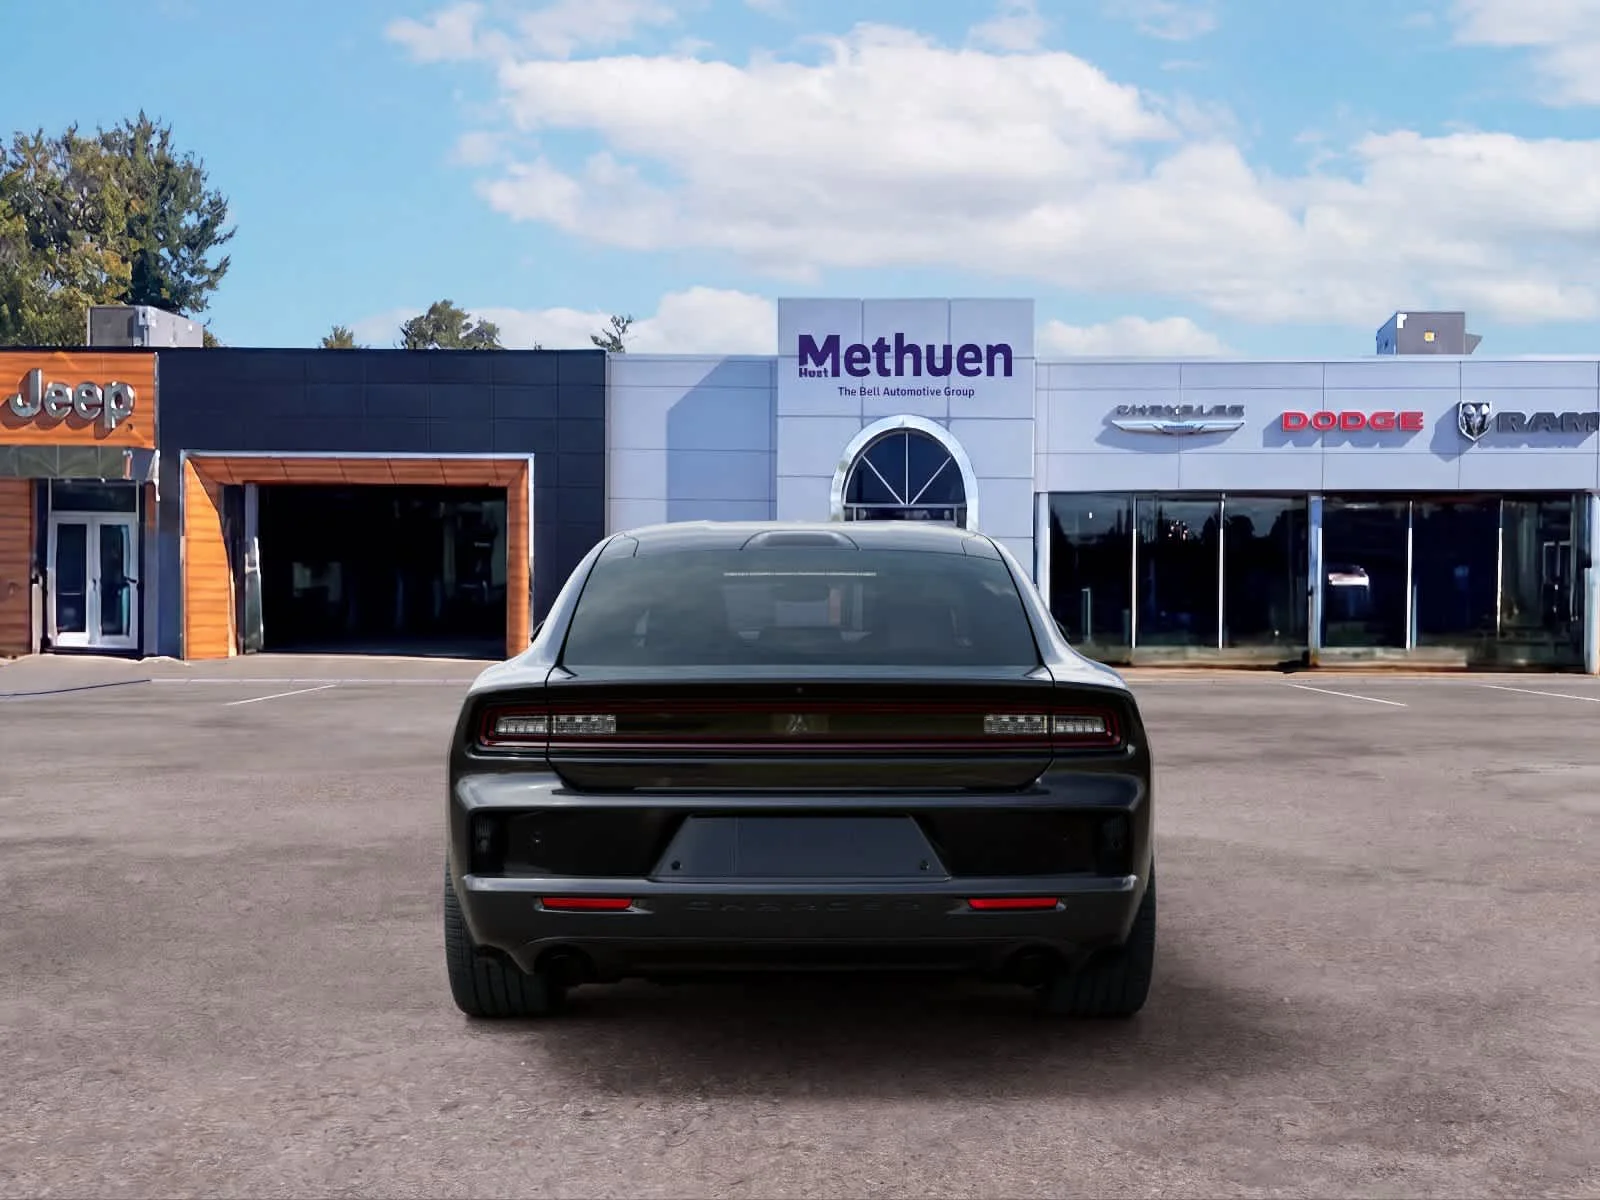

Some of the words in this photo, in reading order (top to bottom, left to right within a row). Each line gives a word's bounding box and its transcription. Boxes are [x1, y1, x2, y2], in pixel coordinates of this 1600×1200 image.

[798, 333, 1013, 377] Methuen
[9, 368, 135, 429] Jeep
[838, 386, 857, 396] The
[860, 386, 880, 396] Bell
[883, 386, 941, 397] Automotive
[944, 386, 975, 398] Group
[1282, 411, 1424, 432] DODGE
[1496, 411, 1600, 433] RAM
